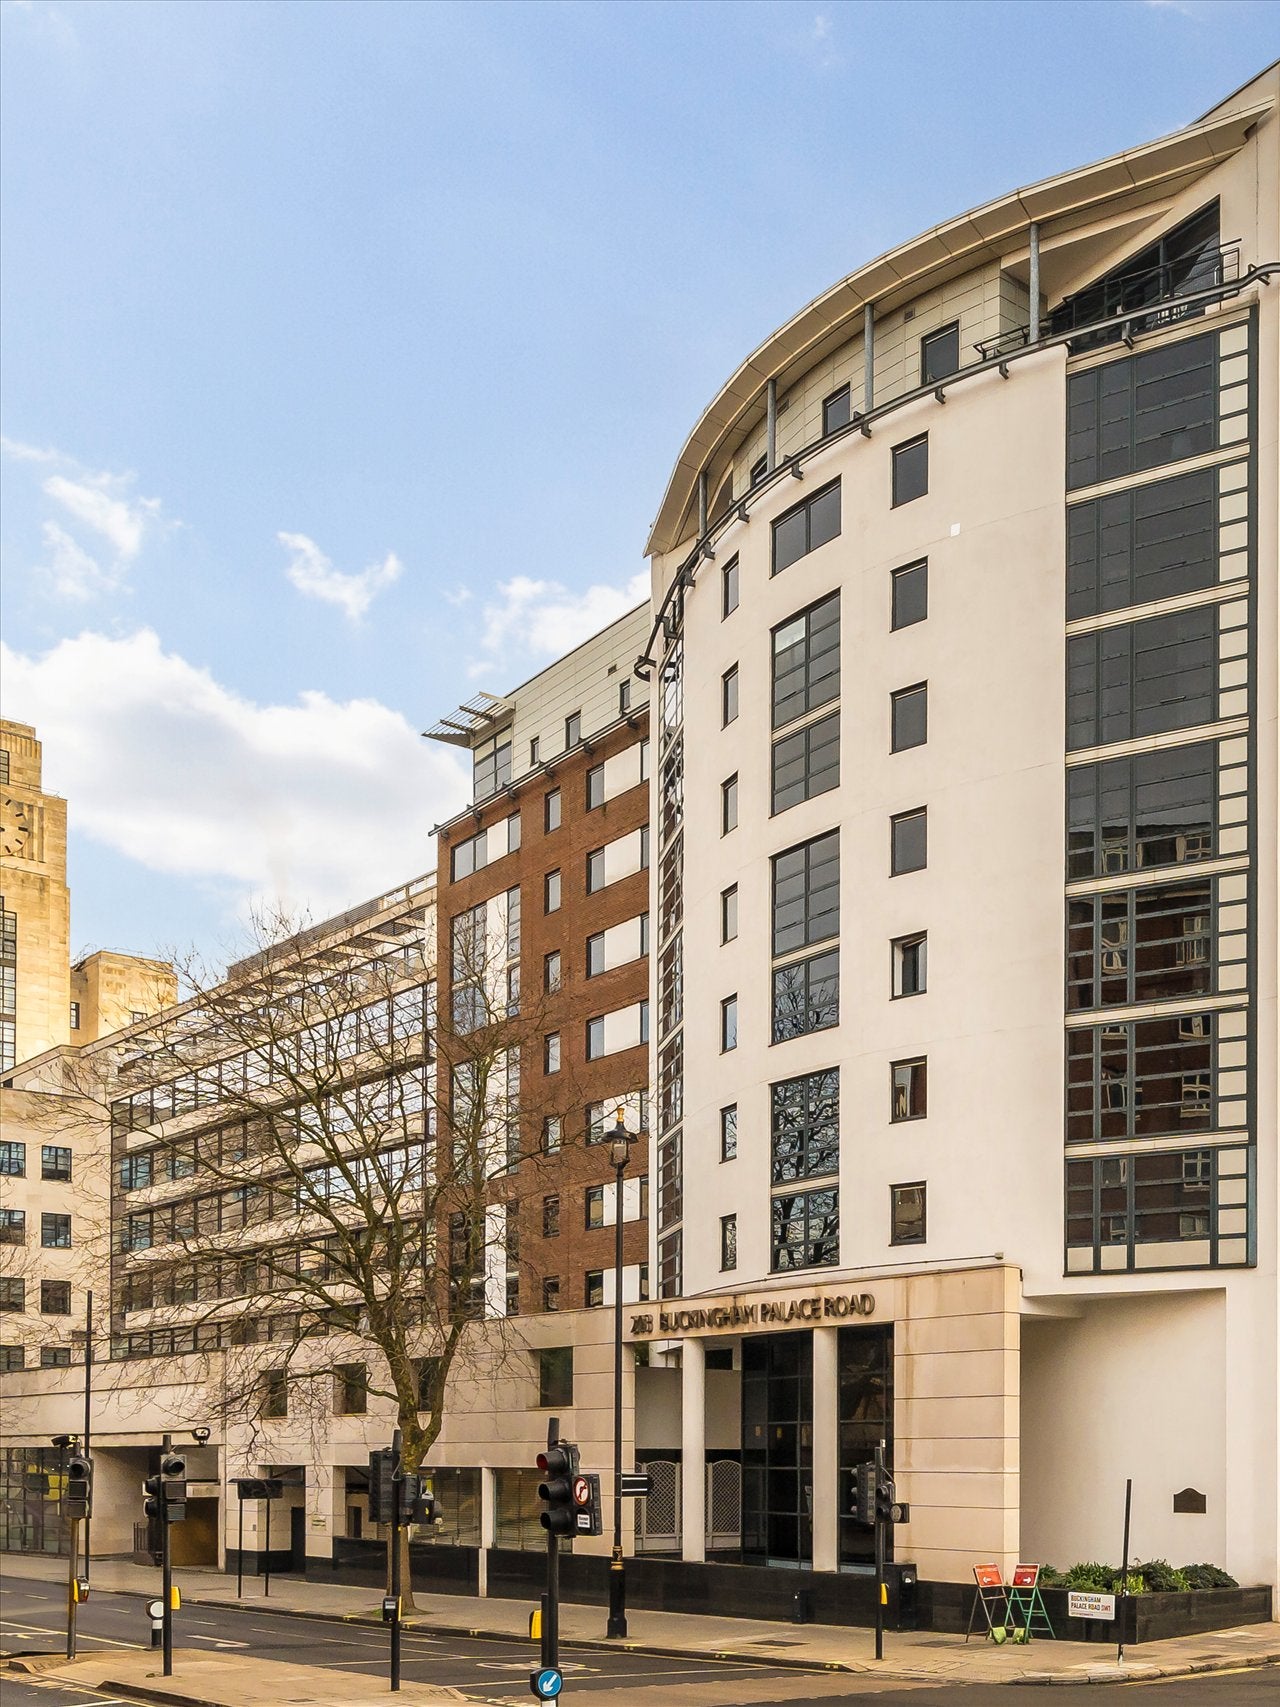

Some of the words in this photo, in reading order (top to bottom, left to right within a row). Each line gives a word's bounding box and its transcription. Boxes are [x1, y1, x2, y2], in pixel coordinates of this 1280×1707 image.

[760, 1296, 822, 1322] PALACE
[823, 1293, 876, 1318] ROAD
[1088, 1603, 1100, 1611] ROAD
